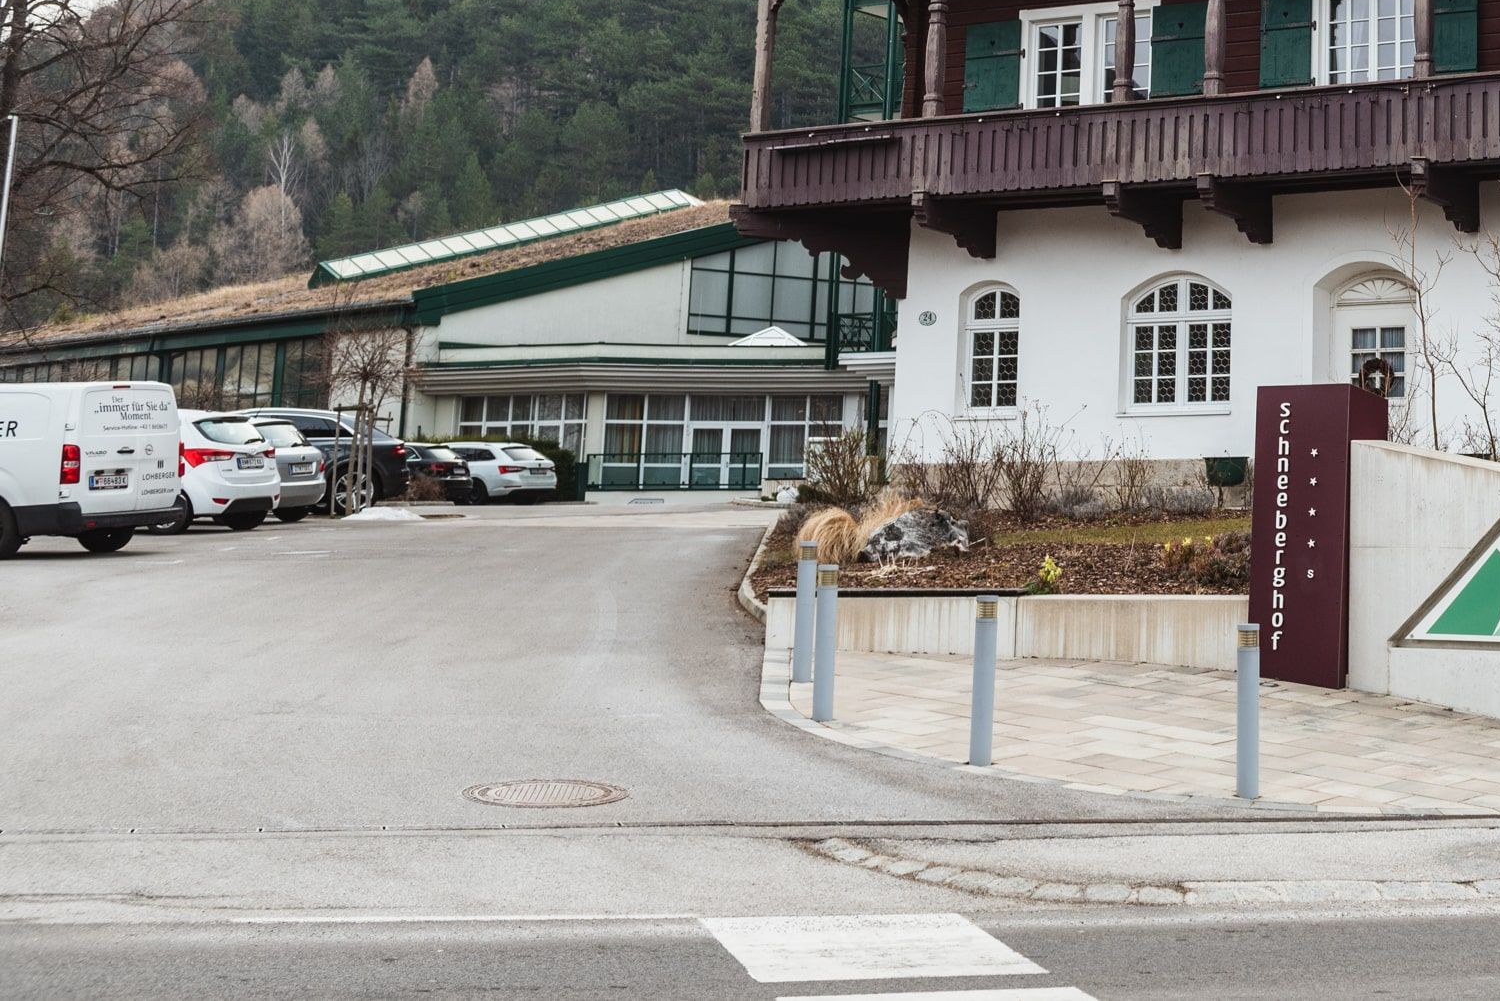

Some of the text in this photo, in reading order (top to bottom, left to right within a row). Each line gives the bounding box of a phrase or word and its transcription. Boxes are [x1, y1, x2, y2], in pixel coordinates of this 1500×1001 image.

[923, 312, 932, 321] 24
[132, 401, 144, 412] für
[145, 401, 158, 412] Sie
[142, 472, 175, 481] LOHBERGER
[1271, 402, 1291, 650] schneeberghof
